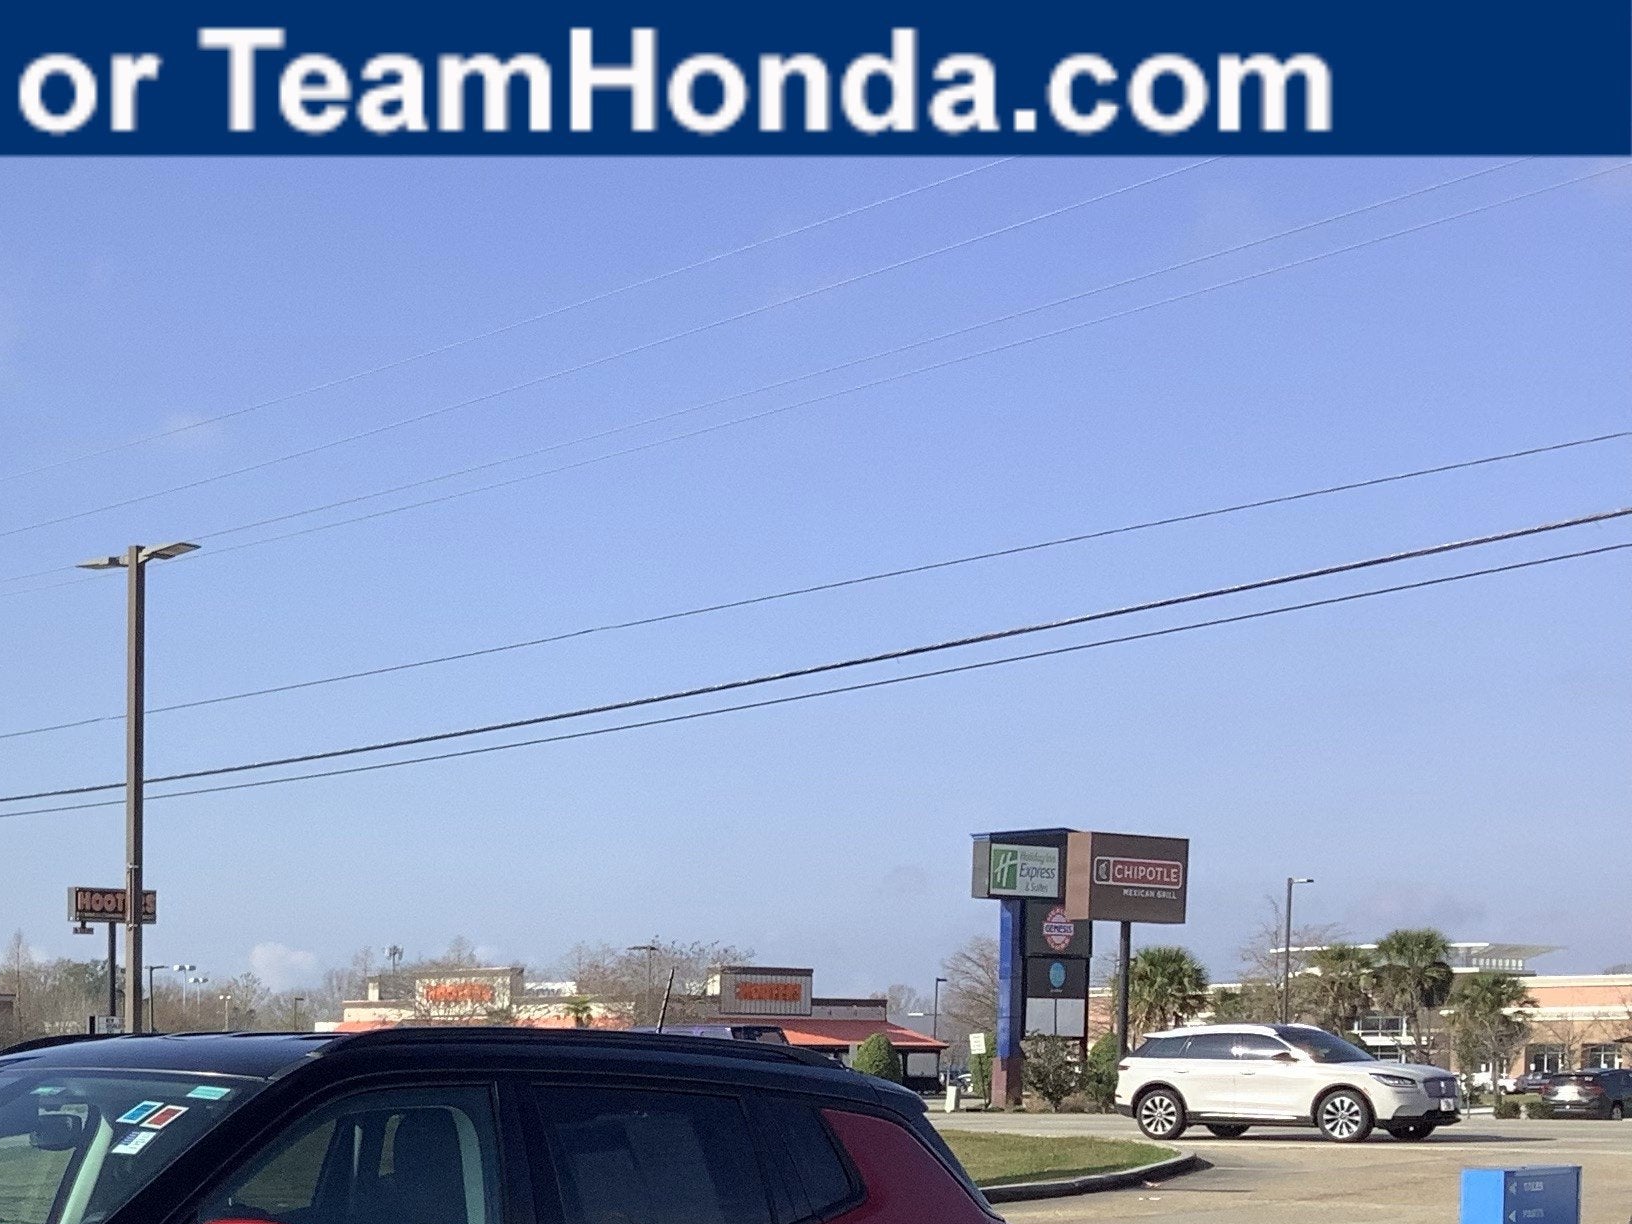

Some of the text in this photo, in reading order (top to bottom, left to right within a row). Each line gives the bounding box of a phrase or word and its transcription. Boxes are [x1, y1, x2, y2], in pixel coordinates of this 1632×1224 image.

[1019, 863, 1056, 881] Express
[1114, 864, 1179, 883] CHIPOTLE
[1122, 889, 1177, 899] MEXICAN GRILL
